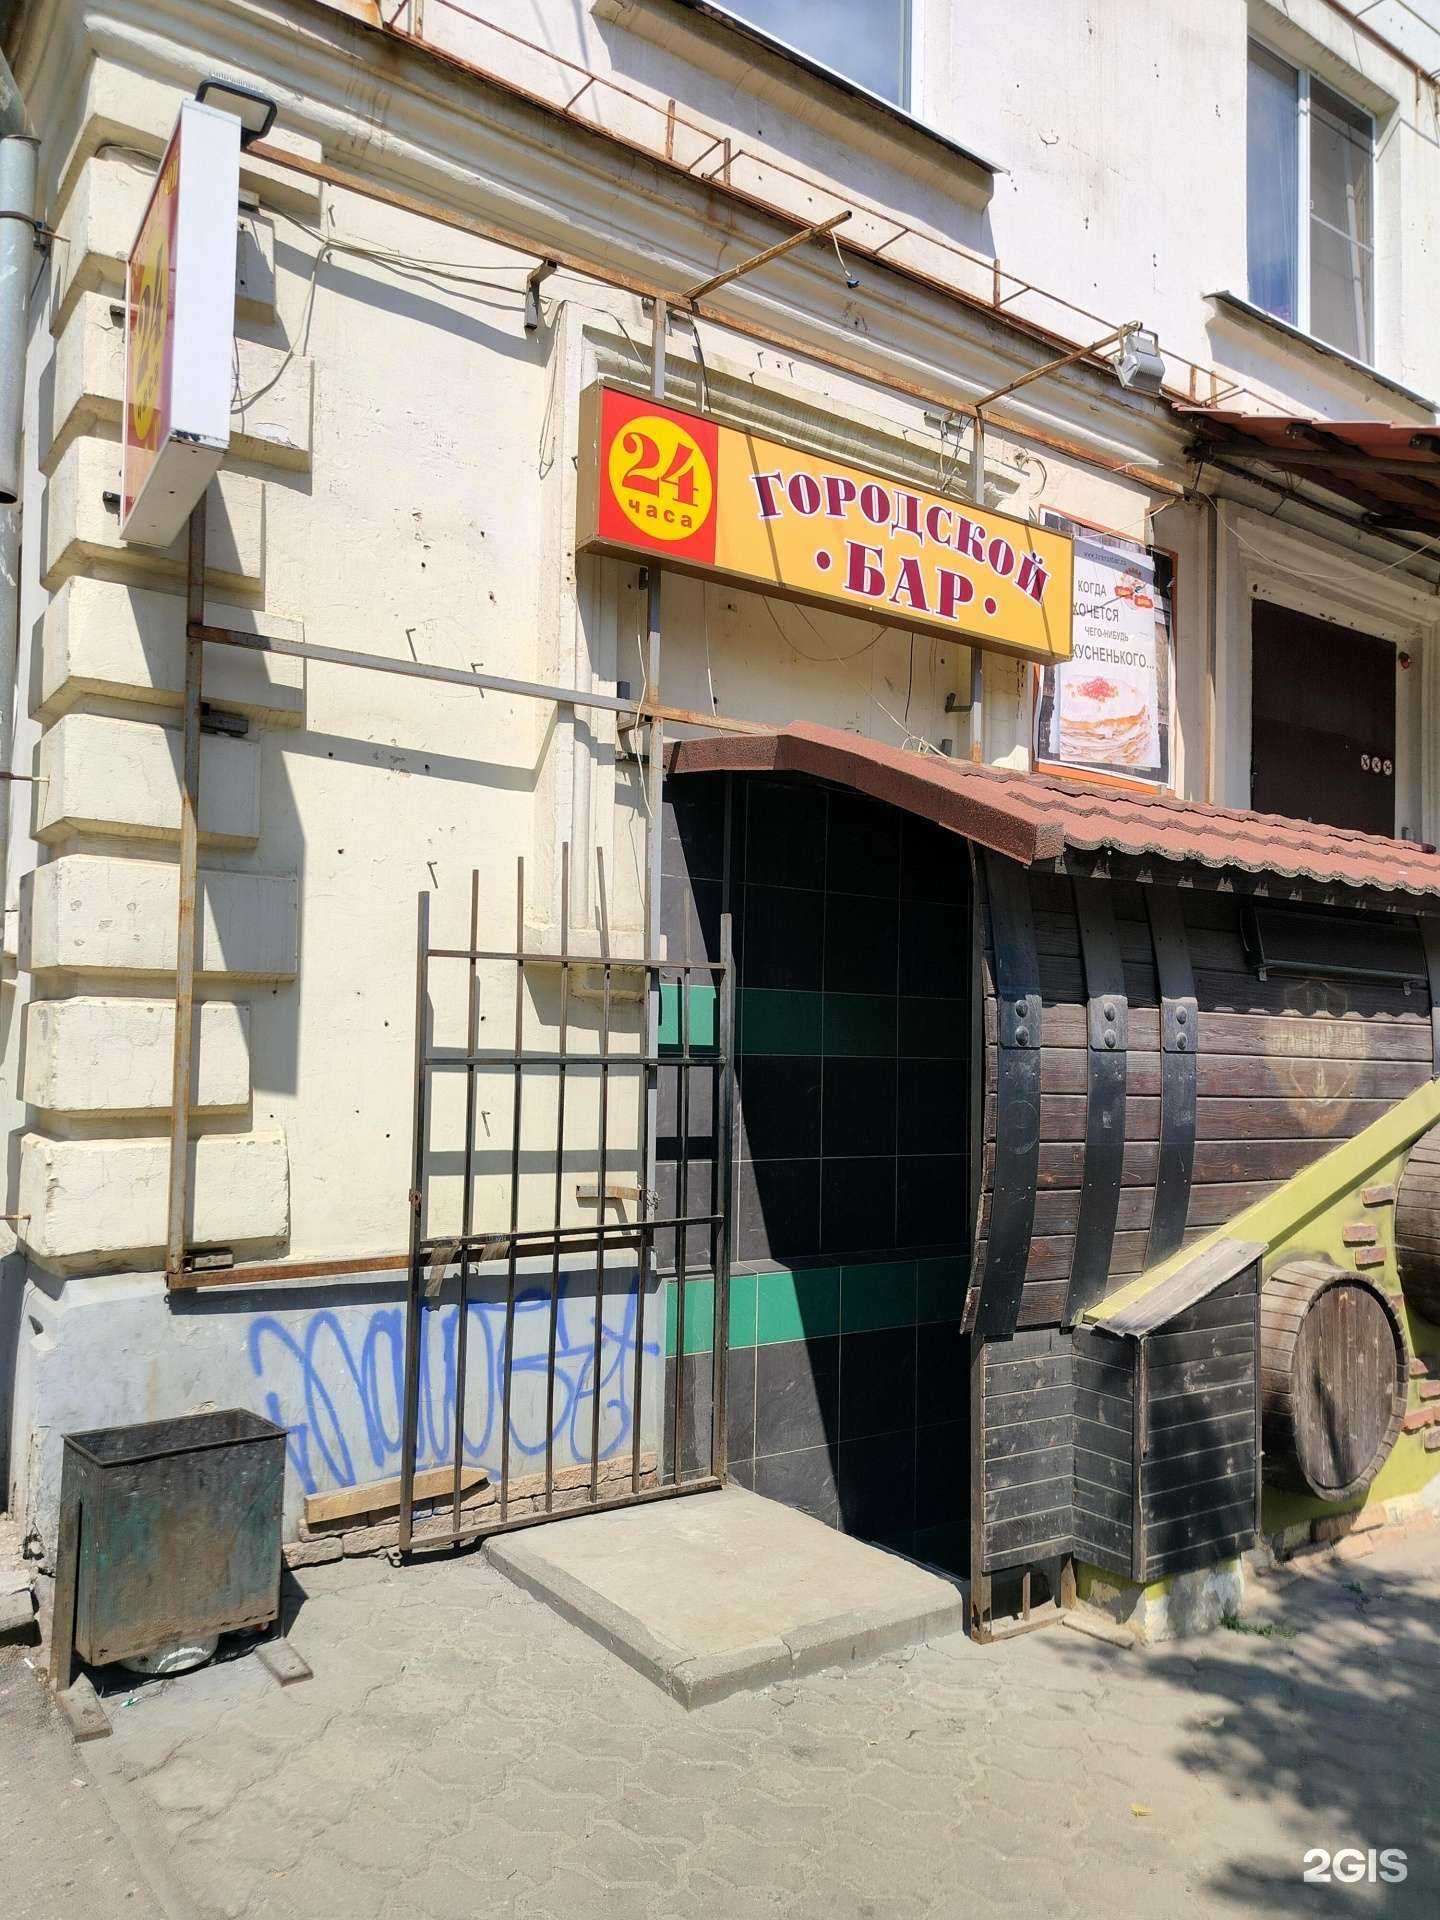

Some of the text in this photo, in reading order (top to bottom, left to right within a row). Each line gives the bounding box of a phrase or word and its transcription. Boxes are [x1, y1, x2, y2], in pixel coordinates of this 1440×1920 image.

[622, 432, 699, 507] 24
[628, 499, 692, 528] часа
[751, 471, 1049, 604] ГОРОДСКОЙ
[844, 540, 975, 619] БАР
[1077, 580, 1107, 597] КОГДА
[1072, 601, 1119, 622] ХОЧЕТСЯ
[1085, 626, 1129, 642] ЧЕГО-НИБУДЬ
[1072, 643, 1155, 669] КУСНЕНЬКОГО...
